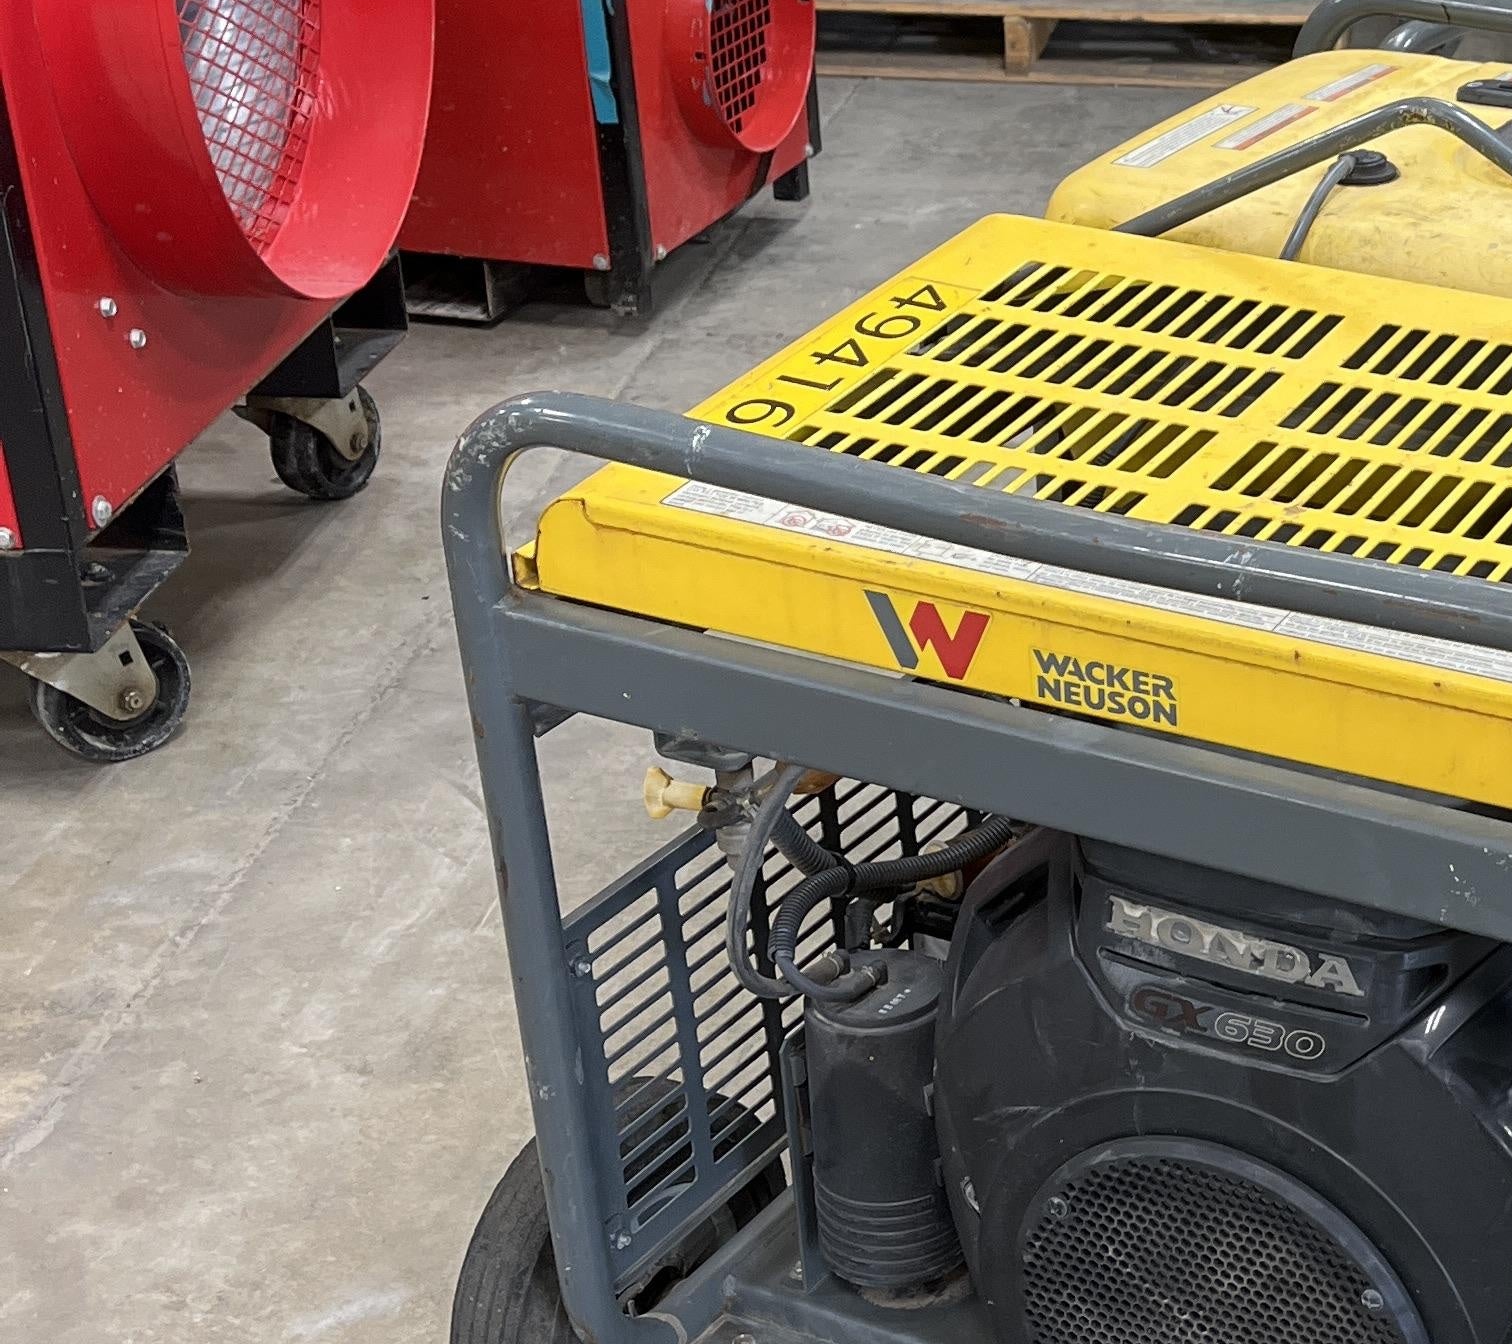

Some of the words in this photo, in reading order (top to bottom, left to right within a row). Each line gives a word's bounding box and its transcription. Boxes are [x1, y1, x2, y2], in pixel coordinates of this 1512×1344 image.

[724, 282, 949, 428] 49416
[1032, 648, 1177, 702] WACKER
[1036, 674, 1178, 727] NEUSON
[1105, 894, 1366, 997] HONDA
